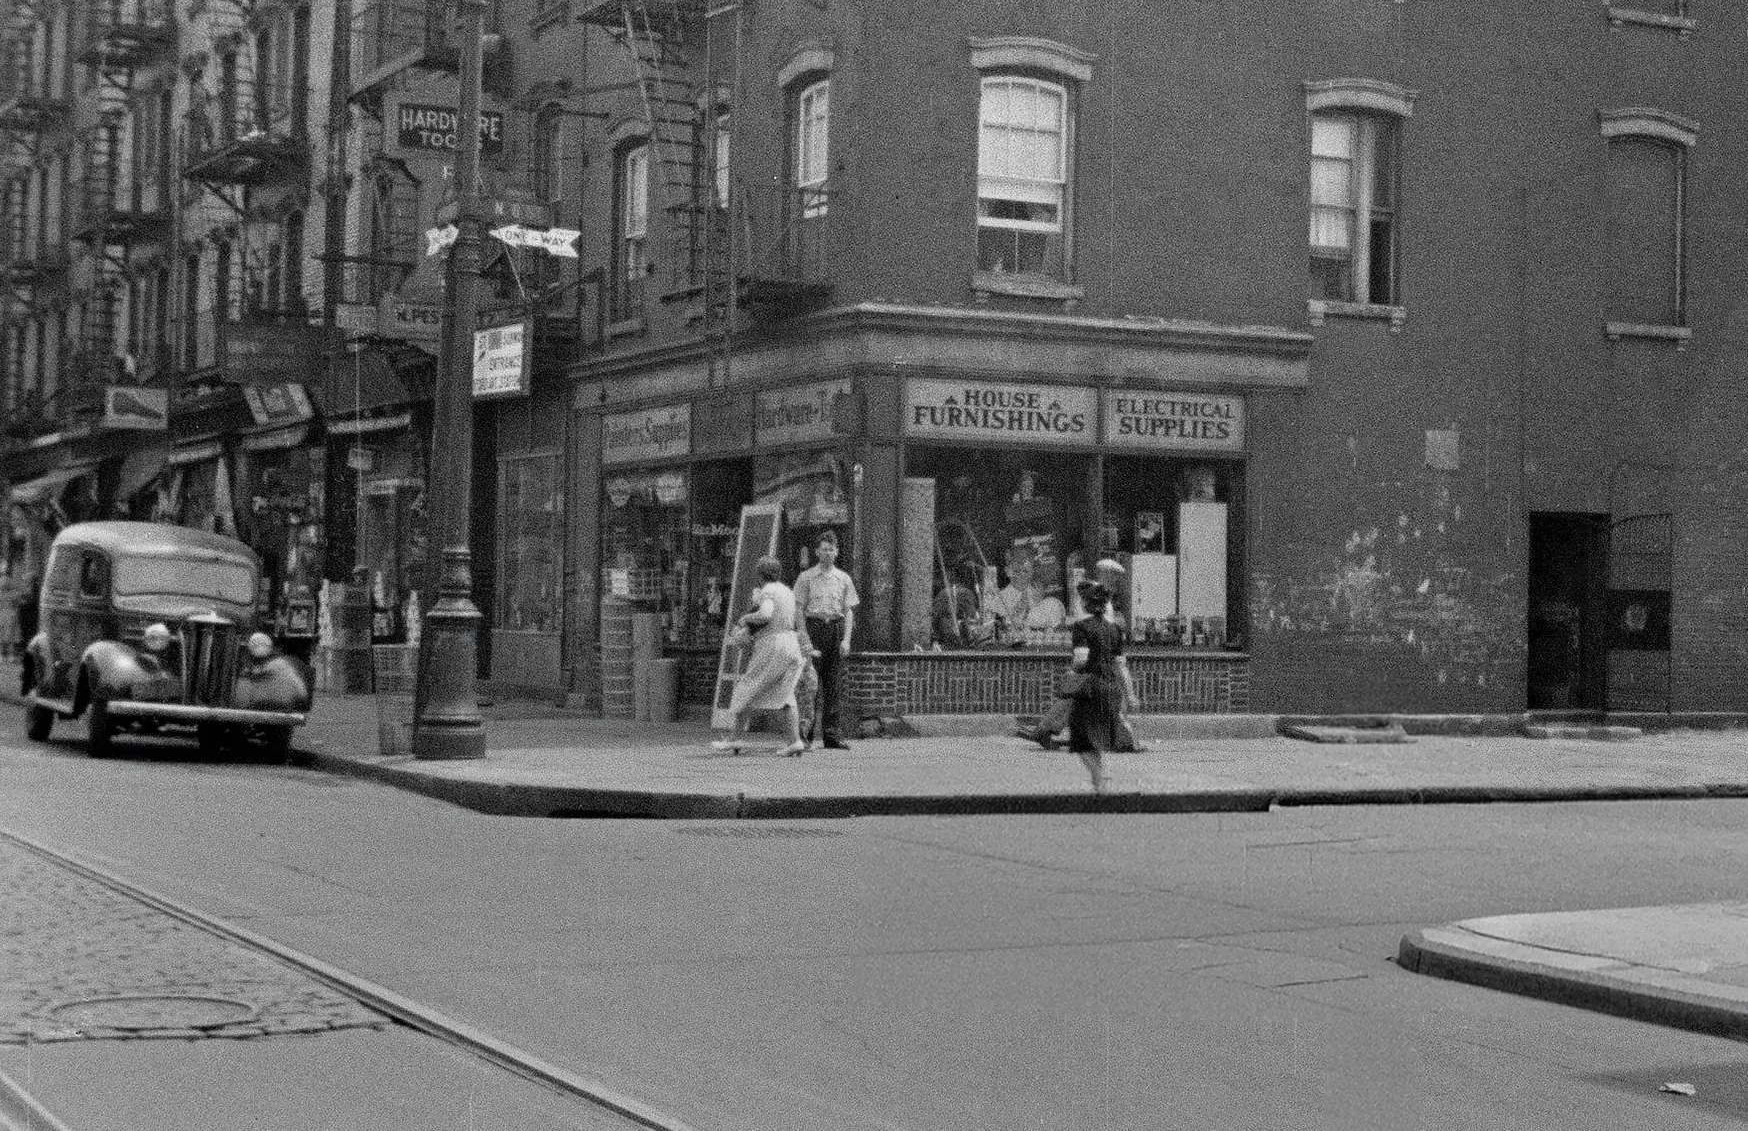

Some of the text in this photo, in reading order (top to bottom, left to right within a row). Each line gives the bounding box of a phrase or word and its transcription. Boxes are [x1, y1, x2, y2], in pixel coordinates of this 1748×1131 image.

[401, 108, 500, 140] HARDRE
[964, 389, 1041, 411] HOUSE
[1116, 398, 1234, 419] ELECTRICAL
[914, 406, 1086, 434] FURNISHINGS
[1119, 416, 1230, 440] SUPPLIES
